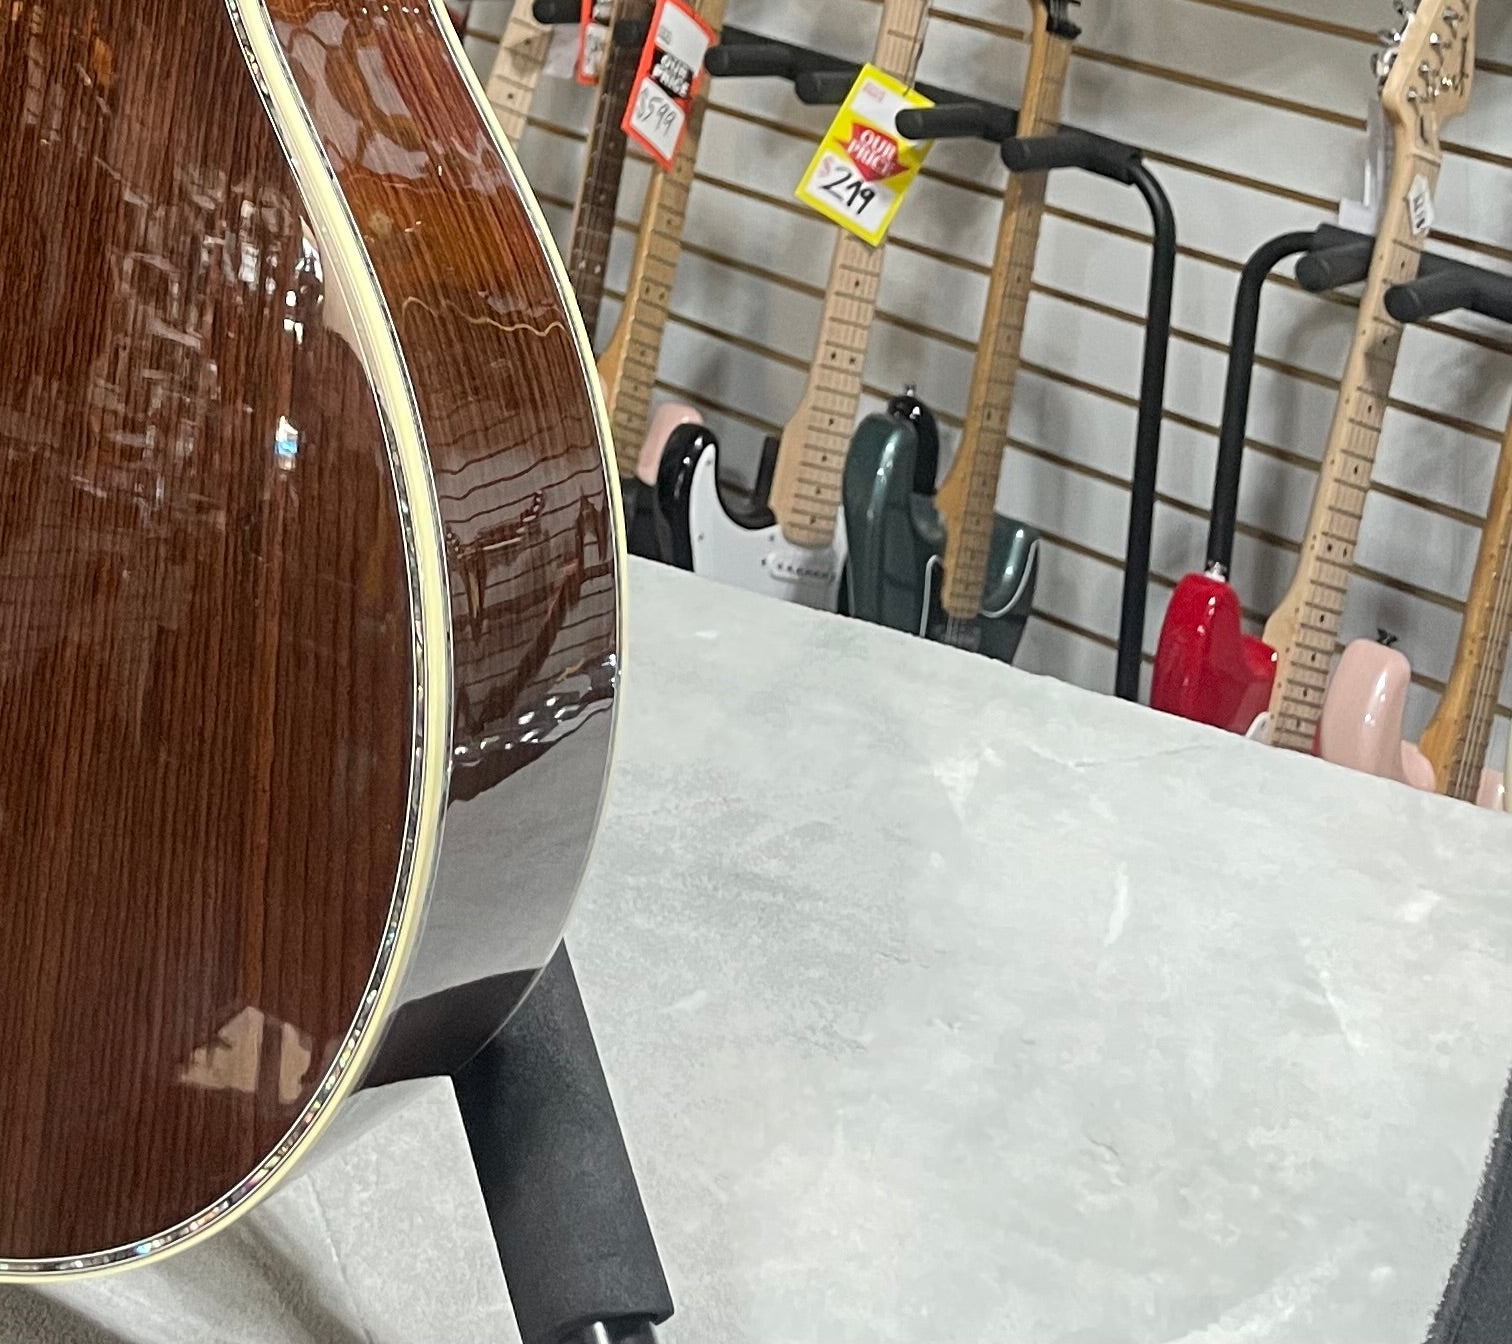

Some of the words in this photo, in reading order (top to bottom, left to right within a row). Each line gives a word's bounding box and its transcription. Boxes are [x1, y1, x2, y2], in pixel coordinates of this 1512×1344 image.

[651, 62, 690, 98] PRICE
[661, 53, 690, 80] OUR
[846, 140, 897, 177] PRICE
[859, 129, 897, 158] OUR
